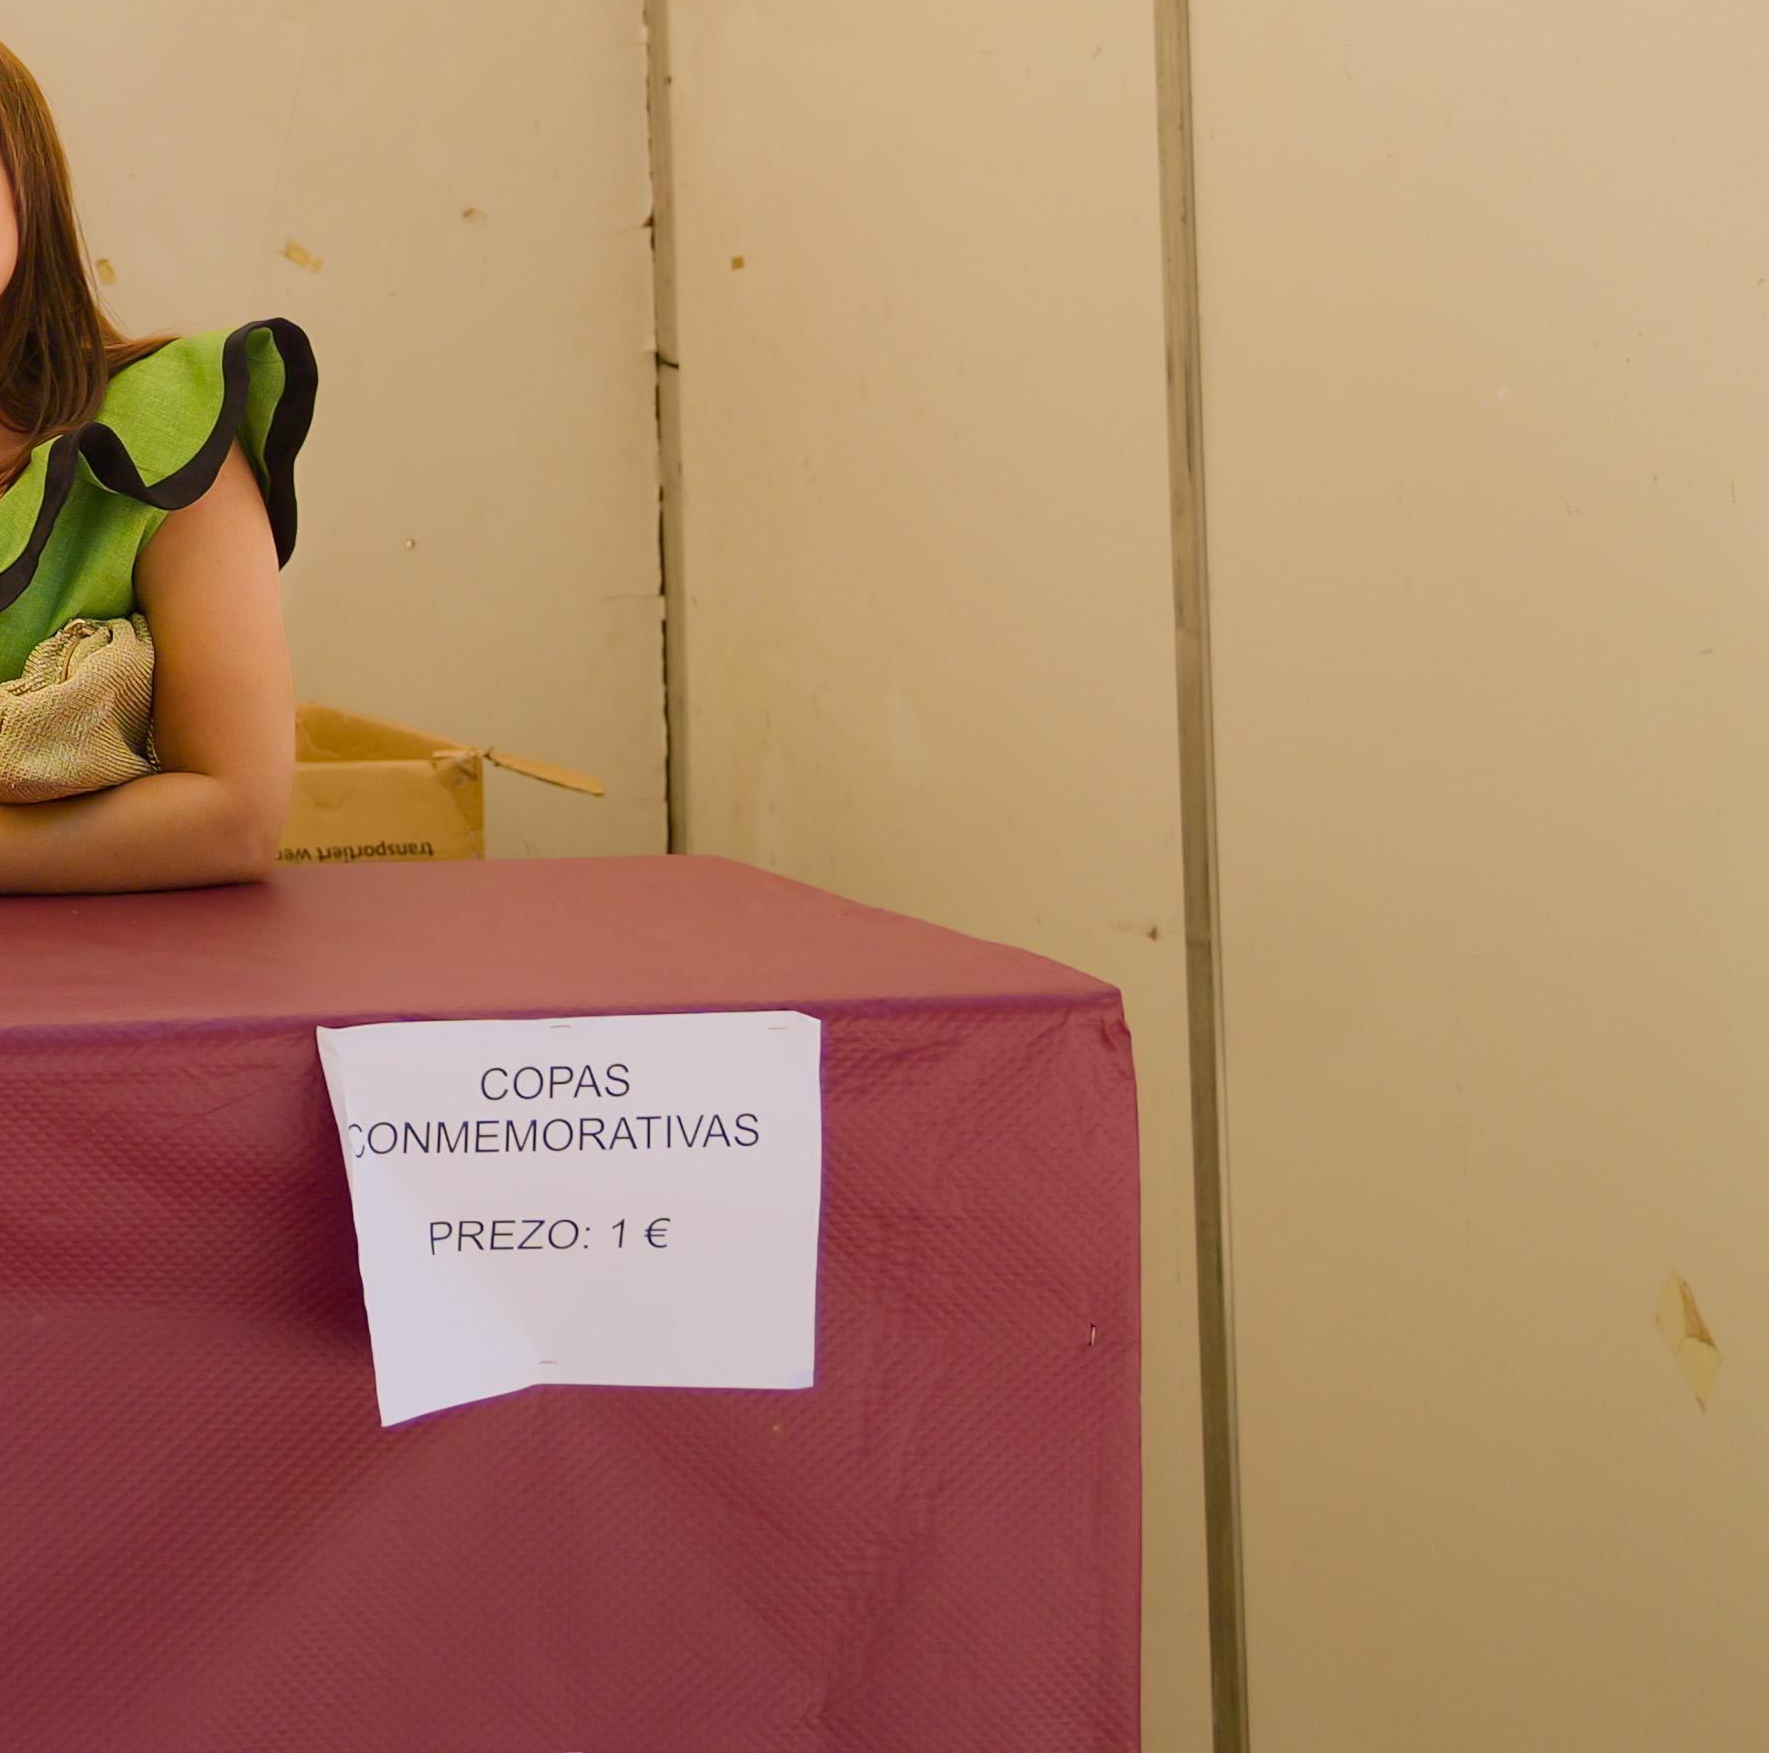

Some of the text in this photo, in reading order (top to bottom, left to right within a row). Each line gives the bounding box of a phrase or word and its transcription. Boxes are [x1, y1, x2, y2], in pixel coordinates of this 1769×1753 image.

[318, 840, 435, 863] transportiert
[480, 1063, 631, 1101] COPAS
[429, 1218, 671, 1256] PREZO: 1 €
